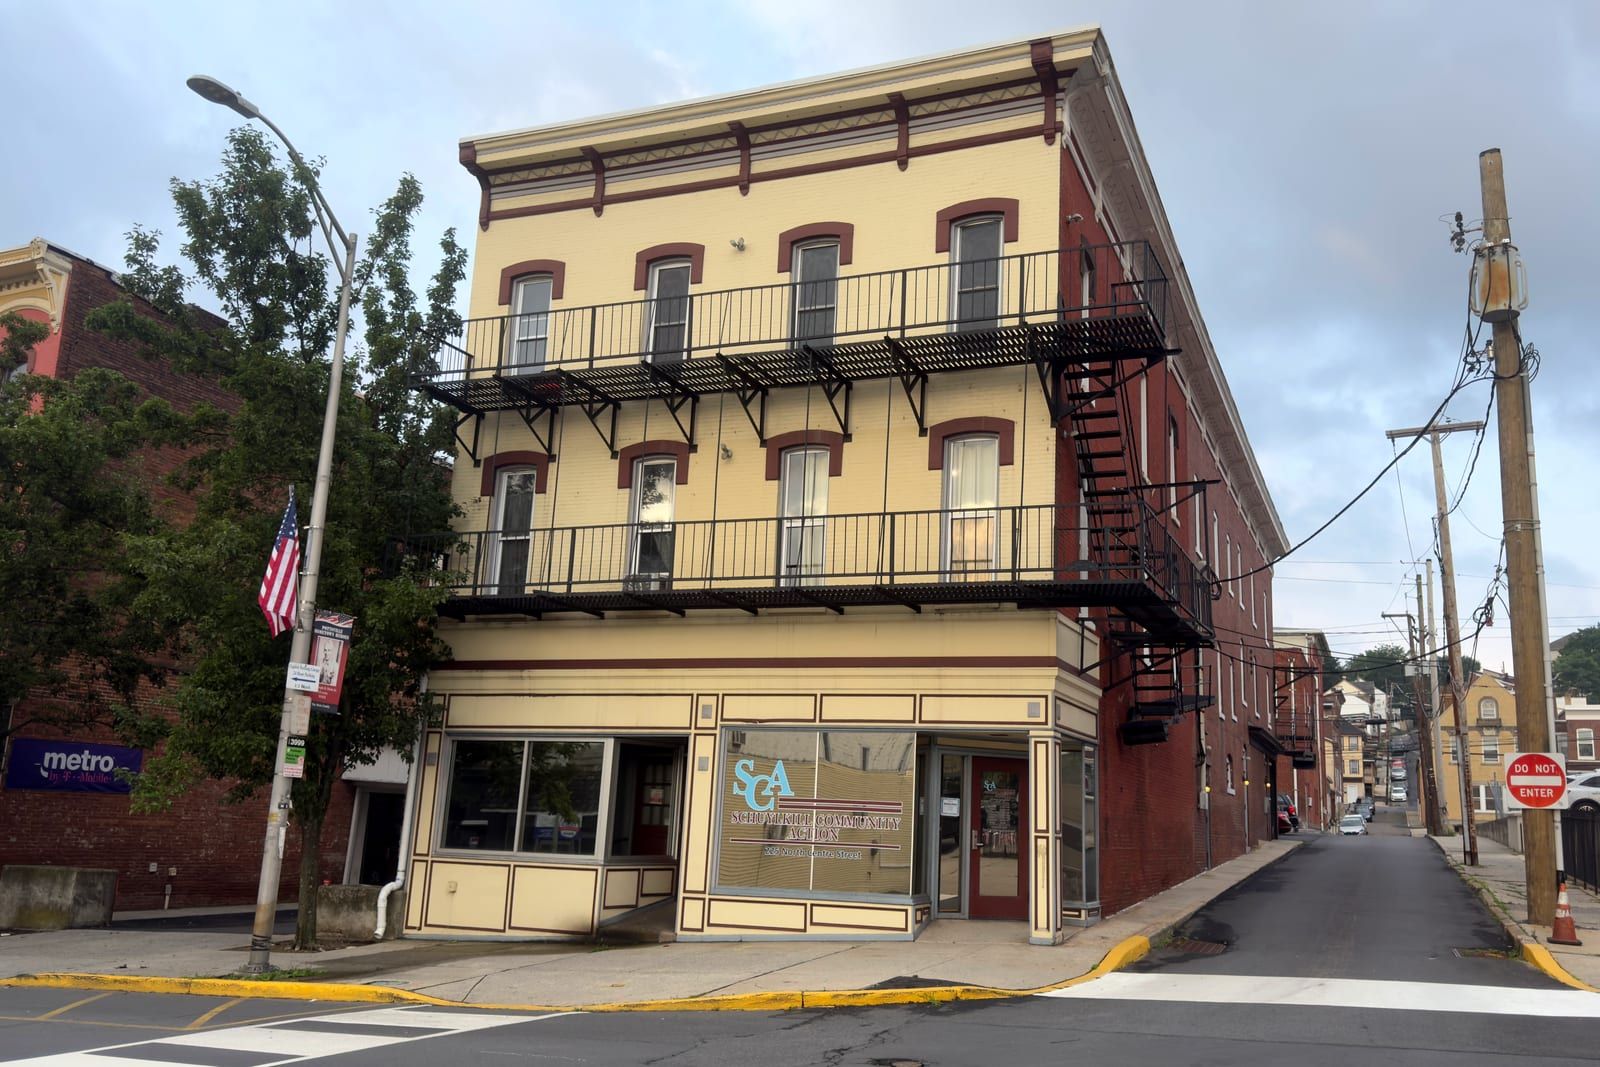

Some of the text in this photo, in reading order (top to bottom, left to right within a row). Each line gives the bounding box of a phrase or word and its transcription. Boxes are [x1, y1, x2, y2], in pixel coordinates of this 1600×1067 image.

[43, 750, 114, 773] metro
[1514, 764, 1556, 773] DO NOT
[48, 771, 60, 784] by
[733, 759, 795, 811] SCA
[1519, 788, 1554, 798] ENTER
[731, 811, 901, 830] SCHUYLKILL COMMUNITY
[785, 827, 840, 841] ACTION
[781, 848, 806, 857] North
[835, 850, 862, 860] Street
